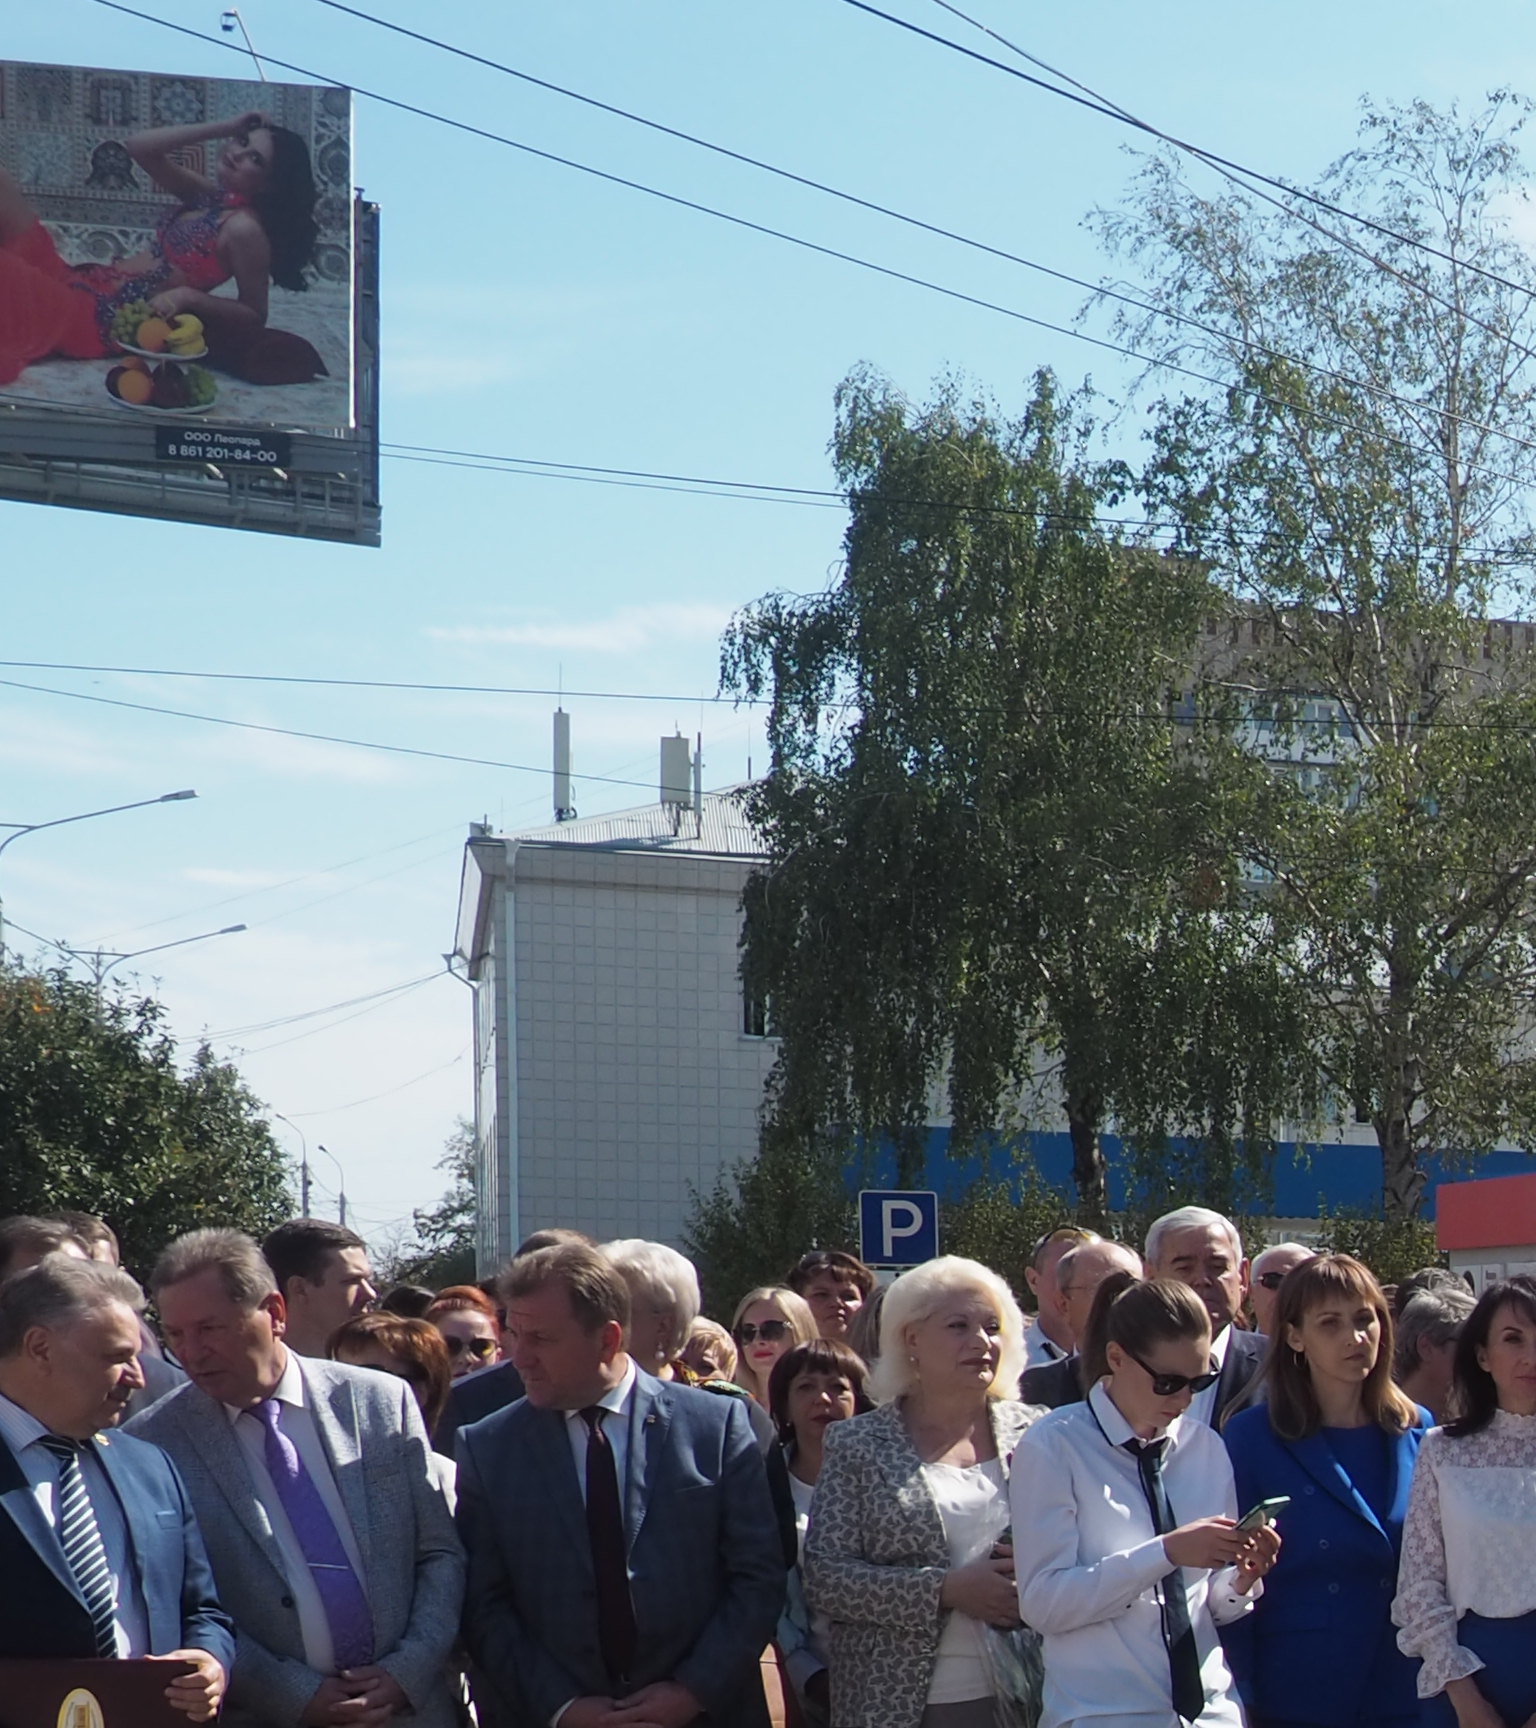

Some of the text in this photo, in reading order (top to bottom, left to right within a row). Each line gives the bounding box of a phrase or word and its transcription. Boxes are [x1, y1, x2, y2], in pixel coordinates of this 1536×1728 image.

[184, 431, 212, 442] ООО
[168, 444, 277, 462] 8 861 201-84-00
[882, 1200, 923, 1257] P
